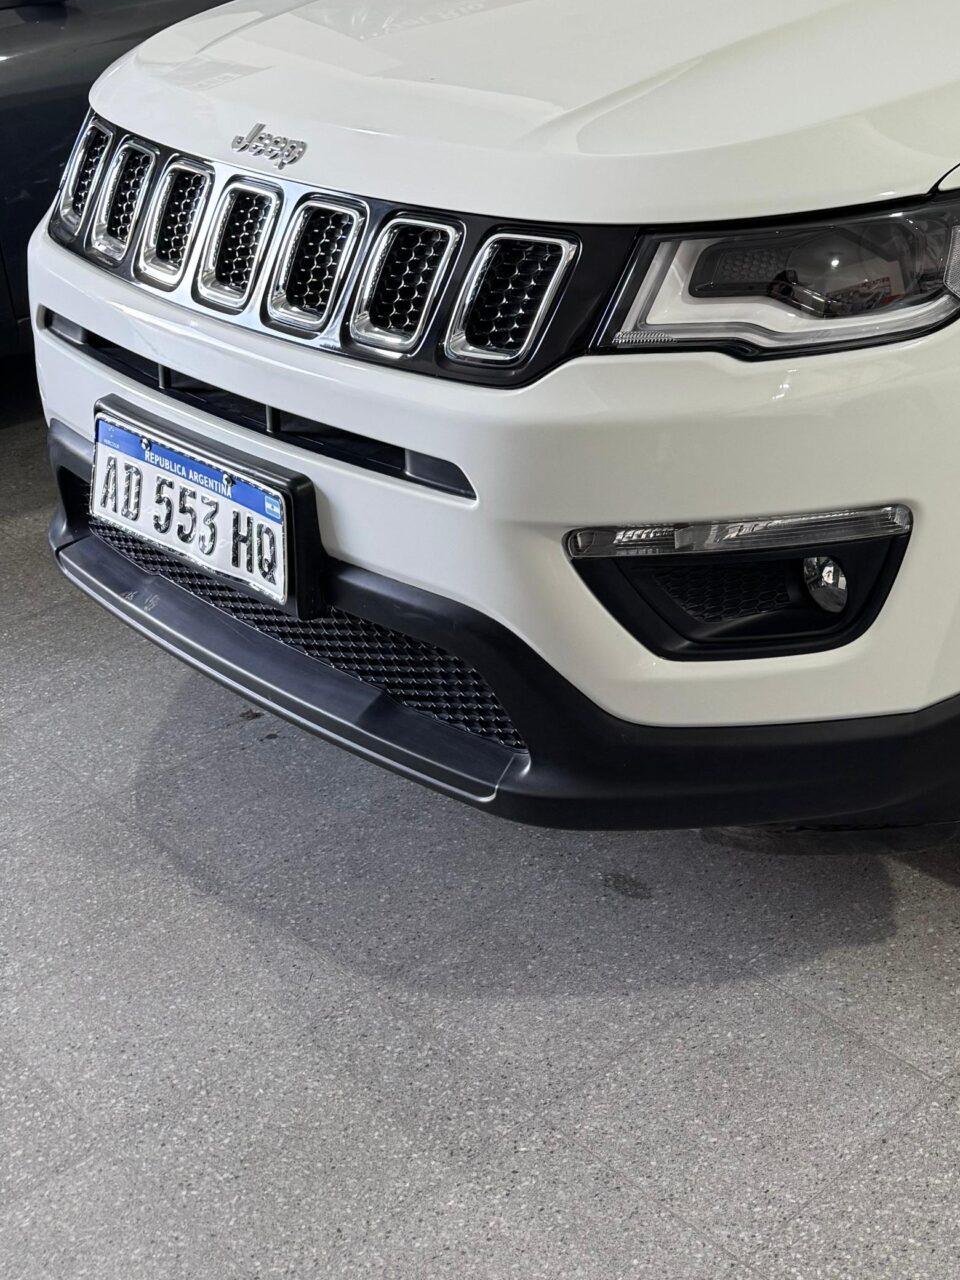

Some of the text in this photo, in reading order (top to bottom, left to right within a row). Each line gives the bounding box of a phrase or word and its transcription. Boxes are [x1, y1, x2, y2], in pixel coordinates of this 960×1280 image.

[231, 122, 307, 170] Jeep
[144, 450, 232, 499] REPUBLICA ARGENTINA
[100, 455, 278, 586] AD 553 HQ
